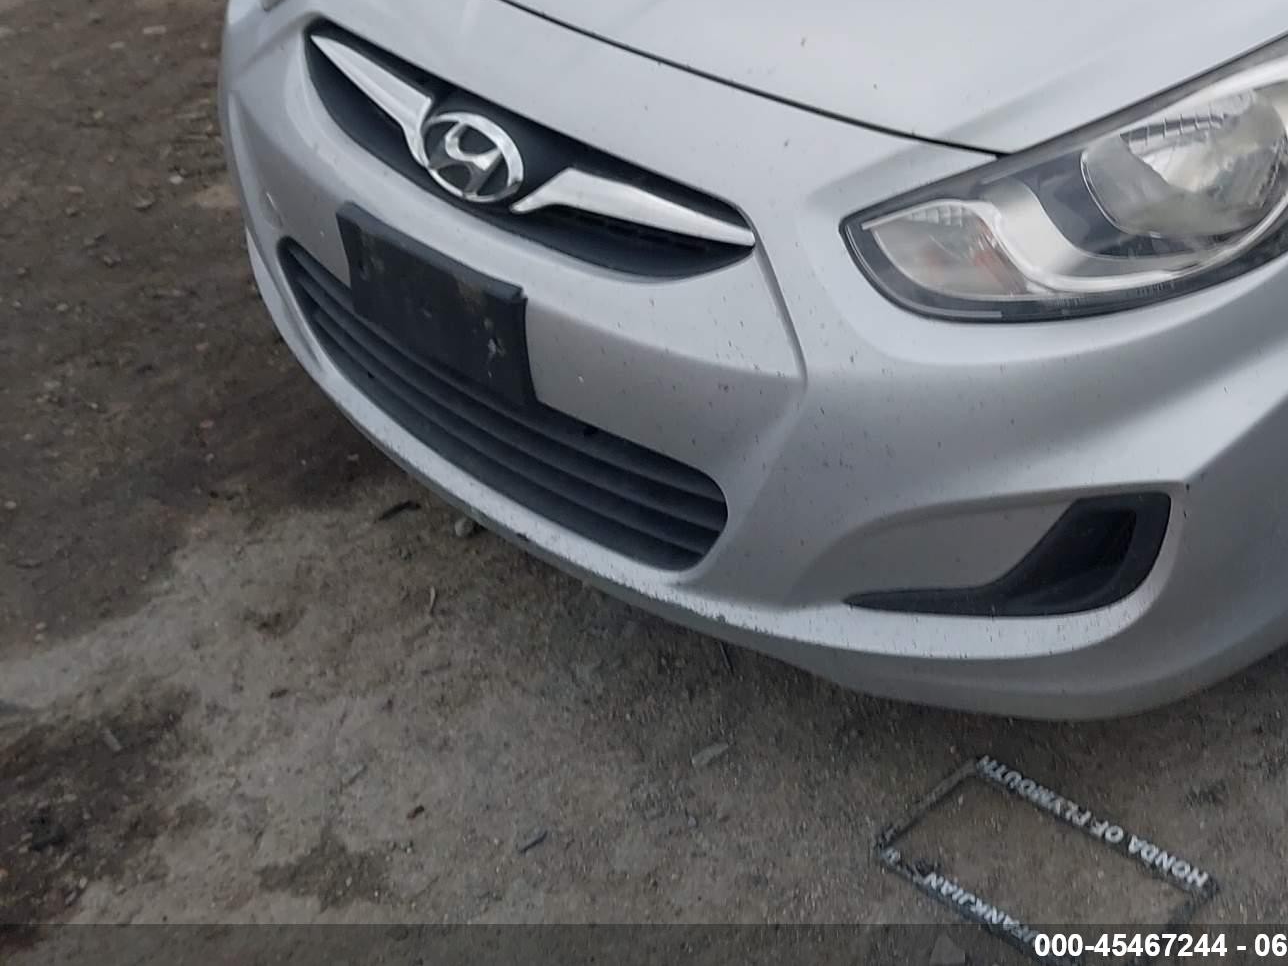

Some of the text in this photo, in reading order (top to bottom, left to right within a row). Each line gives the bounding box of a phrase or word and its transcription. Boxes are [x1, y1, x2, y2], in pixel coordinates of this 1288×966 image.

[975, 754, 1209, 888] HONDA OF PLYMOUTH
